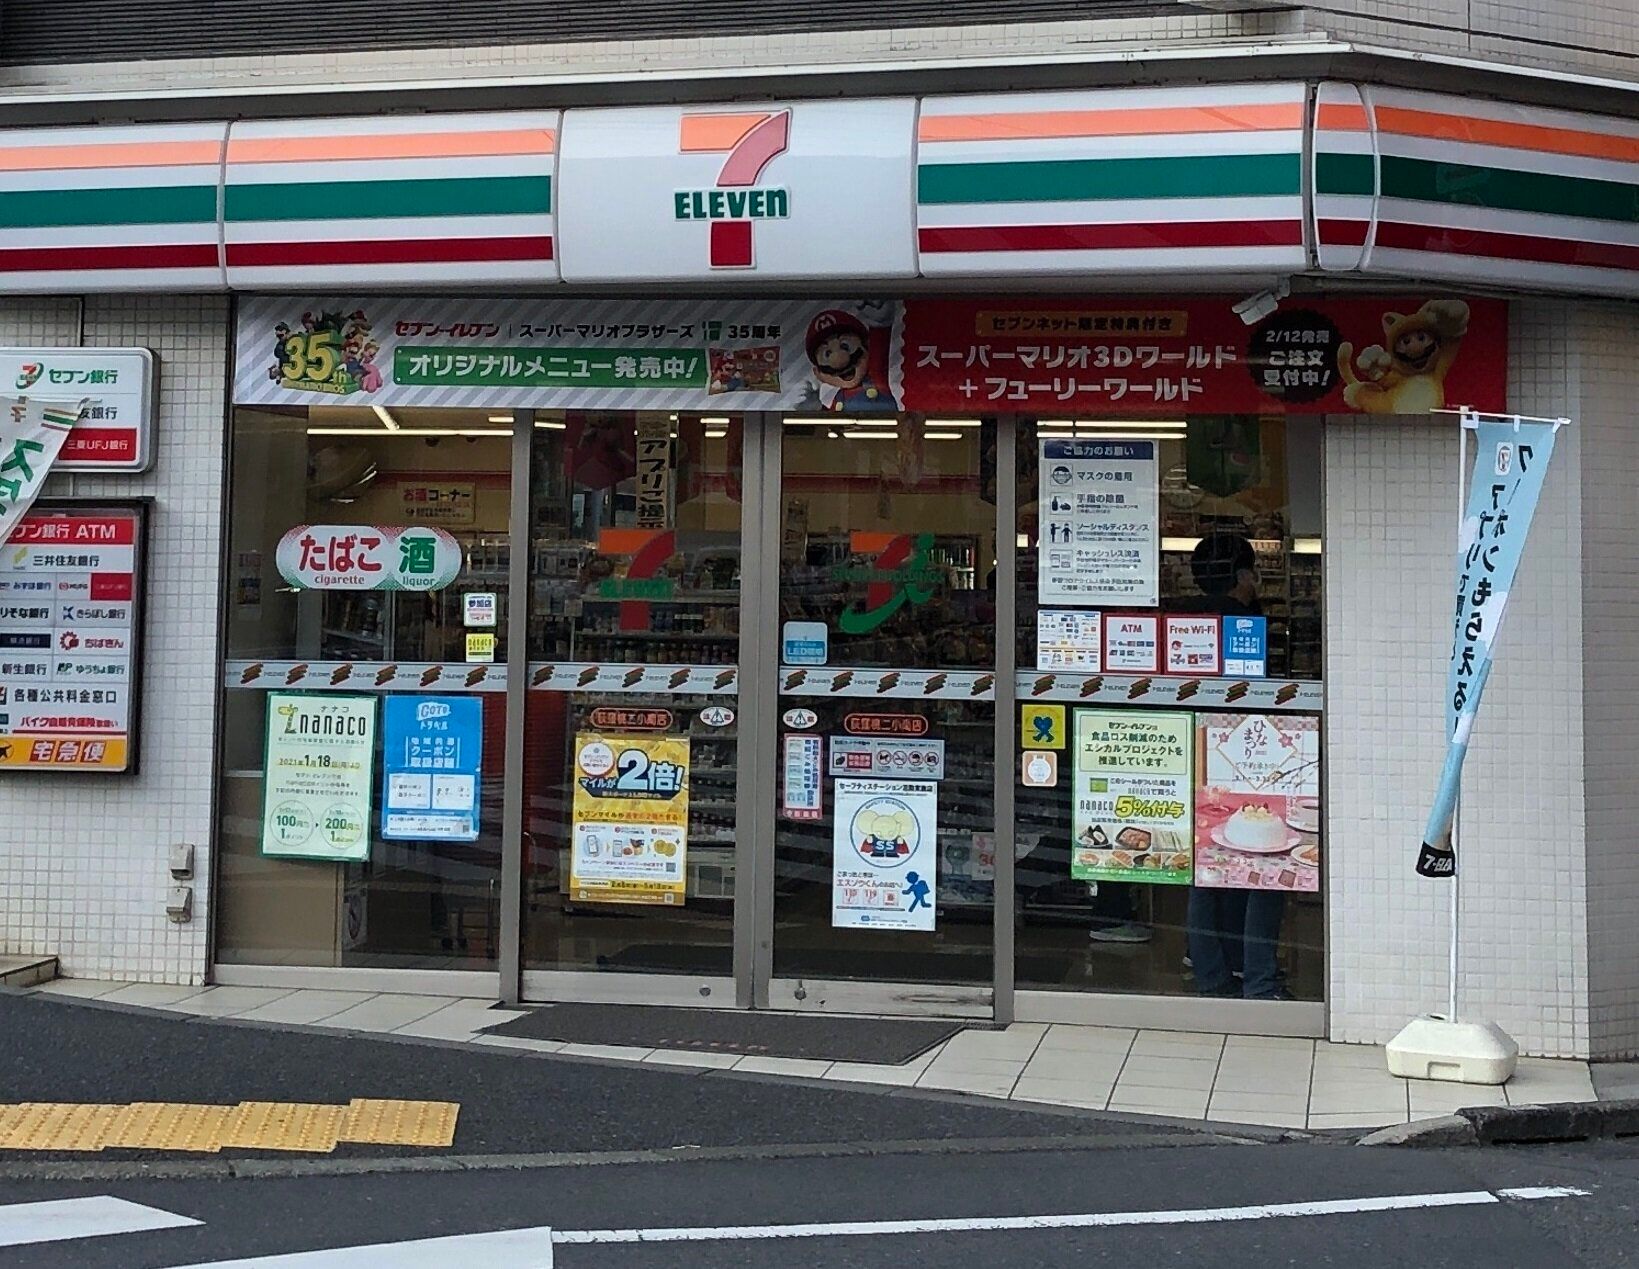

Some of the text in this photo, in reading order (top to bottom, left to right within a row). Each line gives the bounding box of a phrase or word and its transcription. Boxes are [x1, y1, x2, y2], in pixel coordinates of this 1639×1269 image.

[680, 111, 789, 267] 7
[992, 316, 1172, 331] セブンネット限定特典付き
[728, 325, 781, 339] 35周年
[1265, 331, 1330, 344] 2/12発売
[917, 345, 1237, 368] スーパーマリオ3Dワールド
[1269, 350, 1324, 366] ご注文
[49, 369, 118, 384] セブン銀行
[1063, 446, 1134, 457] ご協力のお願い
[1077, 472, 1133, 481] マスクの着用
[76, 524, 116, 539] ATM
[299, 535, 437, 574] たばこ 酒
[33, 555, 99, 567] 三井住友銀行
[314, 575, 436, 586] cigarette liquor
[0, 607, 49, 619] りそな銀行
[76, 608, 126, 620] きらぼし銀行
[1120, 624, 1142, 633] ATM
[1169, 625, 1188, 634] Free
[2, 663, 47, 675] 新生銀行
[76, 664, 125, 675] ゆうちょ銀行
[15, 689, 117, 704] 各種公共料金窓口
[321, 705, 350, 713] ナナコ
[300, 714, 366, 736] nanaco
[1091, 732, 1177, 744] 食品ロス削減のため
[31, 740, 106, 762] 宅急便
[411, 746, 454, 756] クーポン
[1085, 743, 1183, 756] エシカルプロジェクトを
[1080, 800, 1114, 811] nanaco
[1115, 796, 1184, 818] 5%付与
